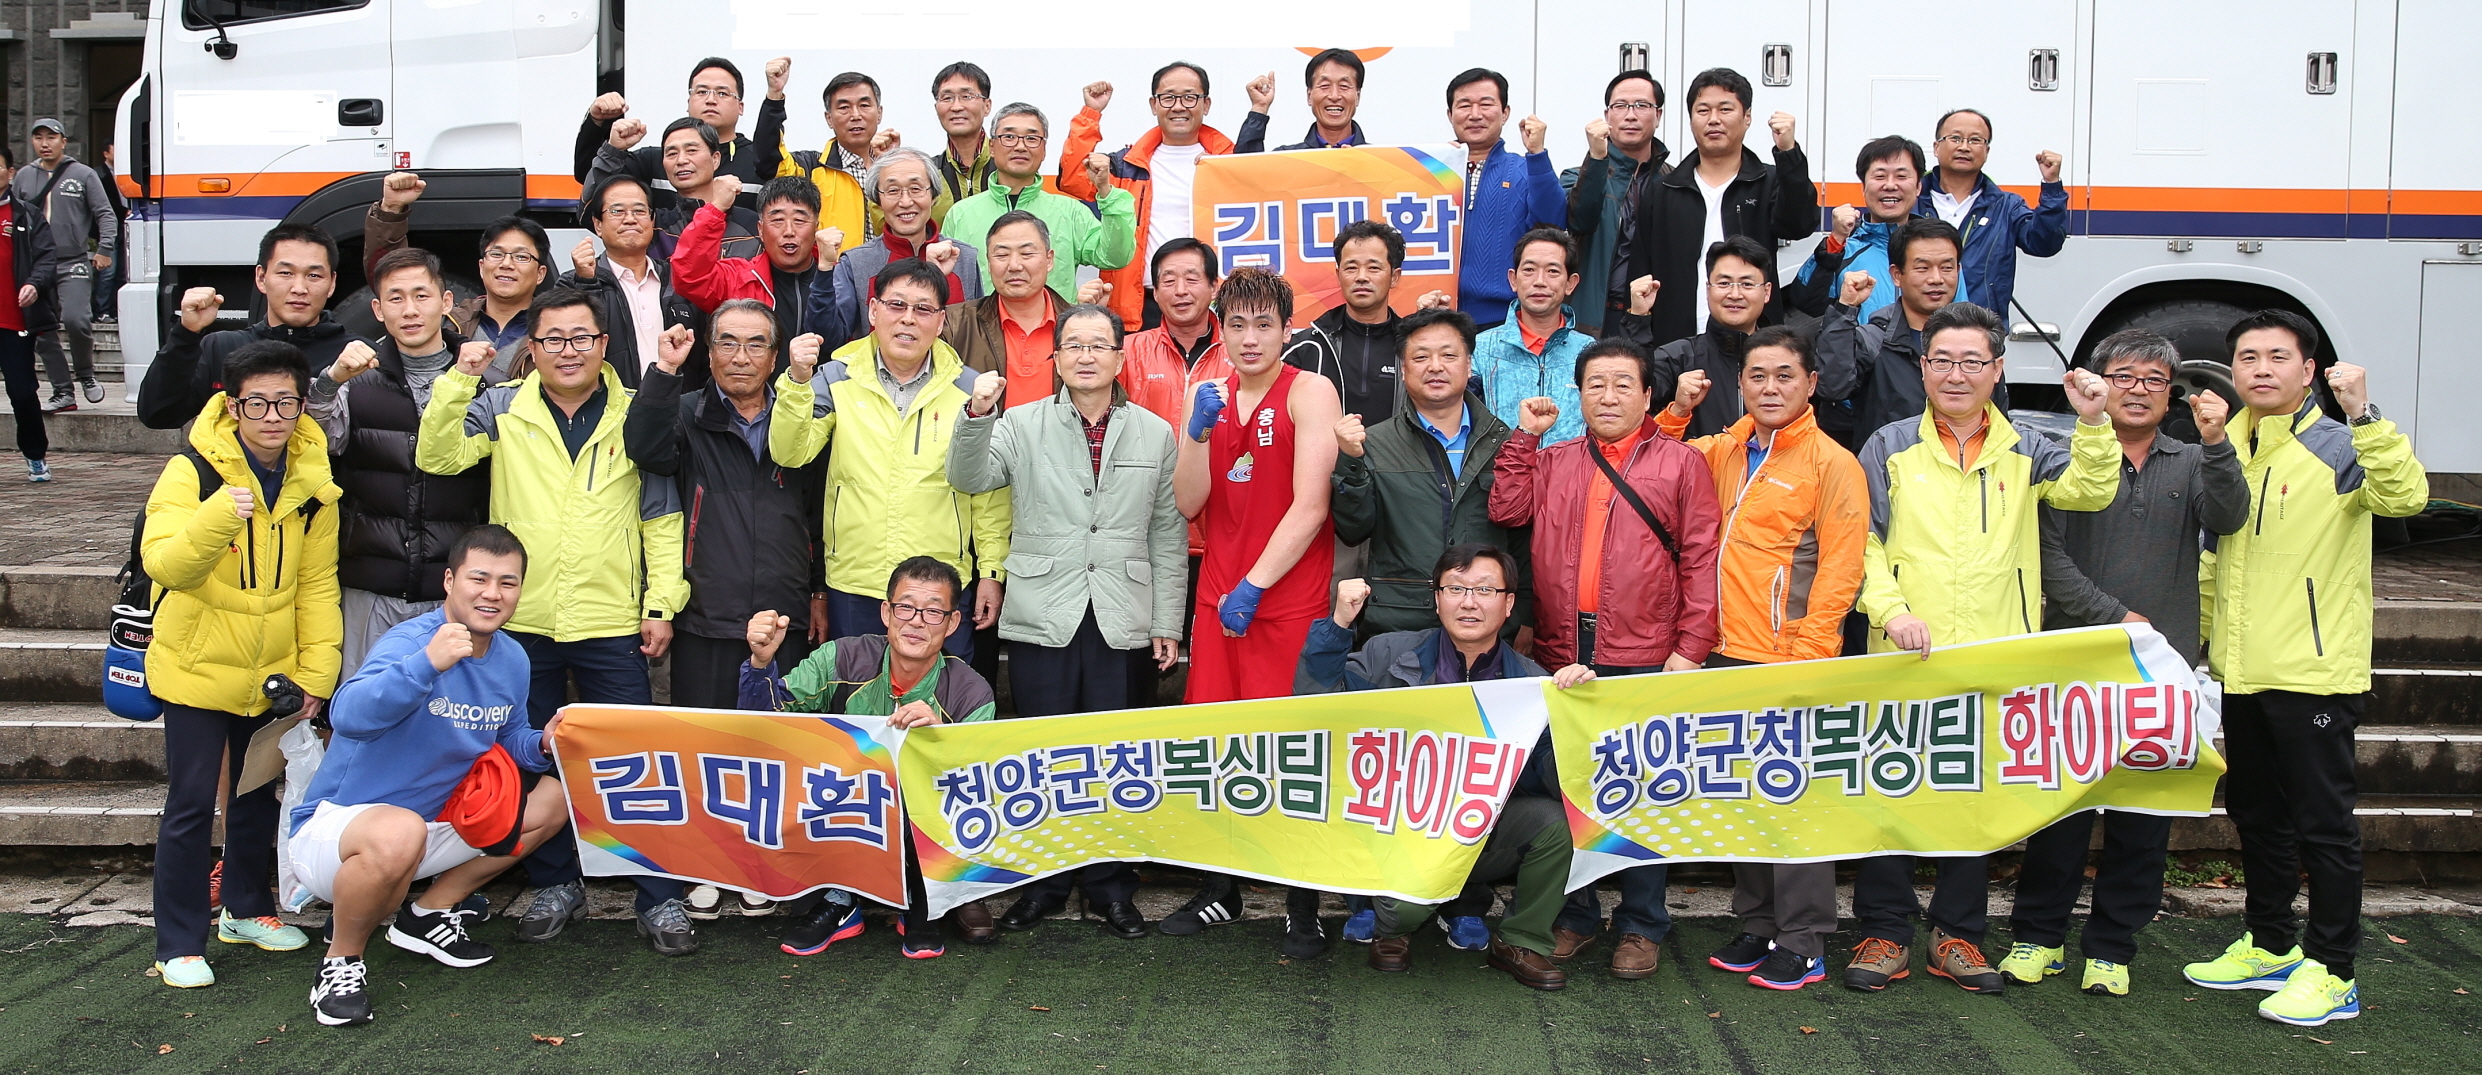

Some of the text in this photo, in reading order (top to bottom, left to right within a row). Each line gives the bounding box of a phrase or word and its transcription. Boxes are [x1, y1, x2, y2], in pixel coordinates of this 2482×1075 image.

[1257, 407, 1275, 447] 충남
[111, 670, 125, 680] TEN
[125, 673, 141, 684] TOP
[453, 720, 502, 732] EXPEDITIO
[1998, 680, 2199, 791] 화이팅!
[589, 750, 896, 852] 김대환
